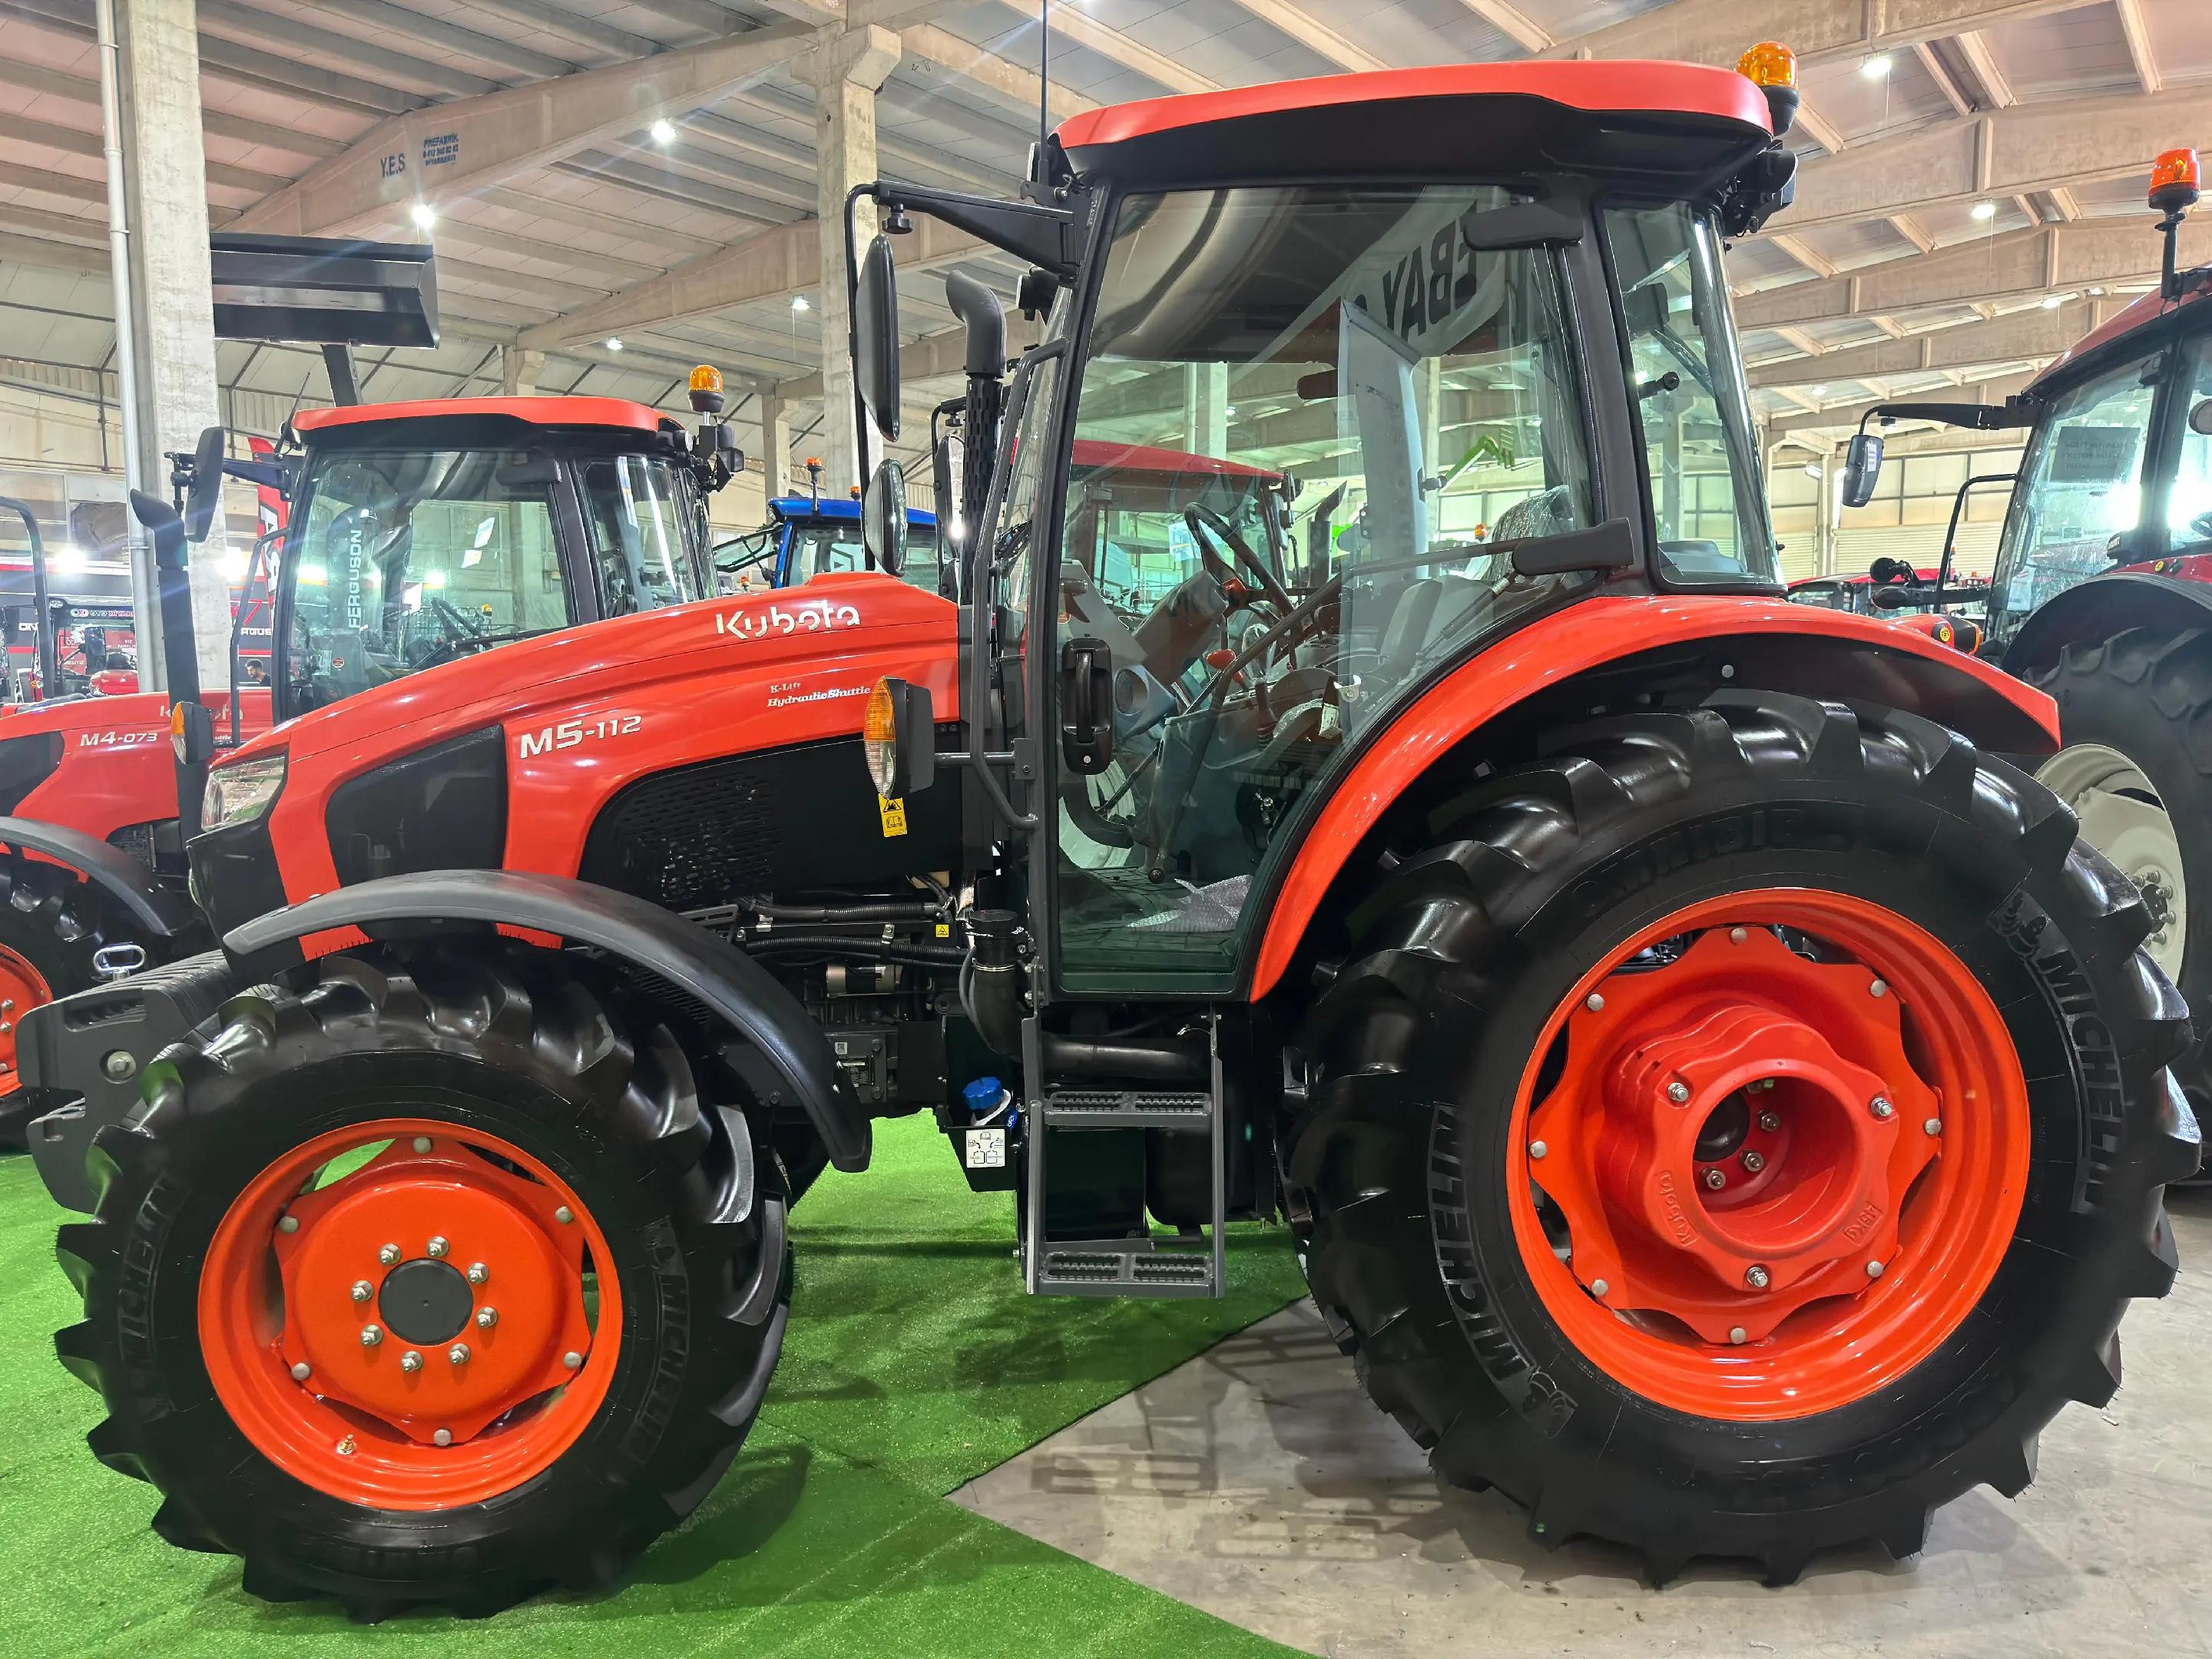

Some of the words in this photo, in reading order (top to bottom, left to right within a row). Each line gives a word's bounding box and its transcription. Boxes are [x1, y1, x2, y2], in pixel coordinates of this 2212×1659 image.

[347, 529, 363, 628] FERGUSON
[716, 600, 861, 640] Kubota
[80, 731, 158, 747] M4-073
[520, 715, 642, 760] M5-112
[2035, 948, 2124, 1204] MICHELIN
[1659, 1172, 1694, 1243] Kubota
[1428, 1108, 1531, 1381] MICHELIN
